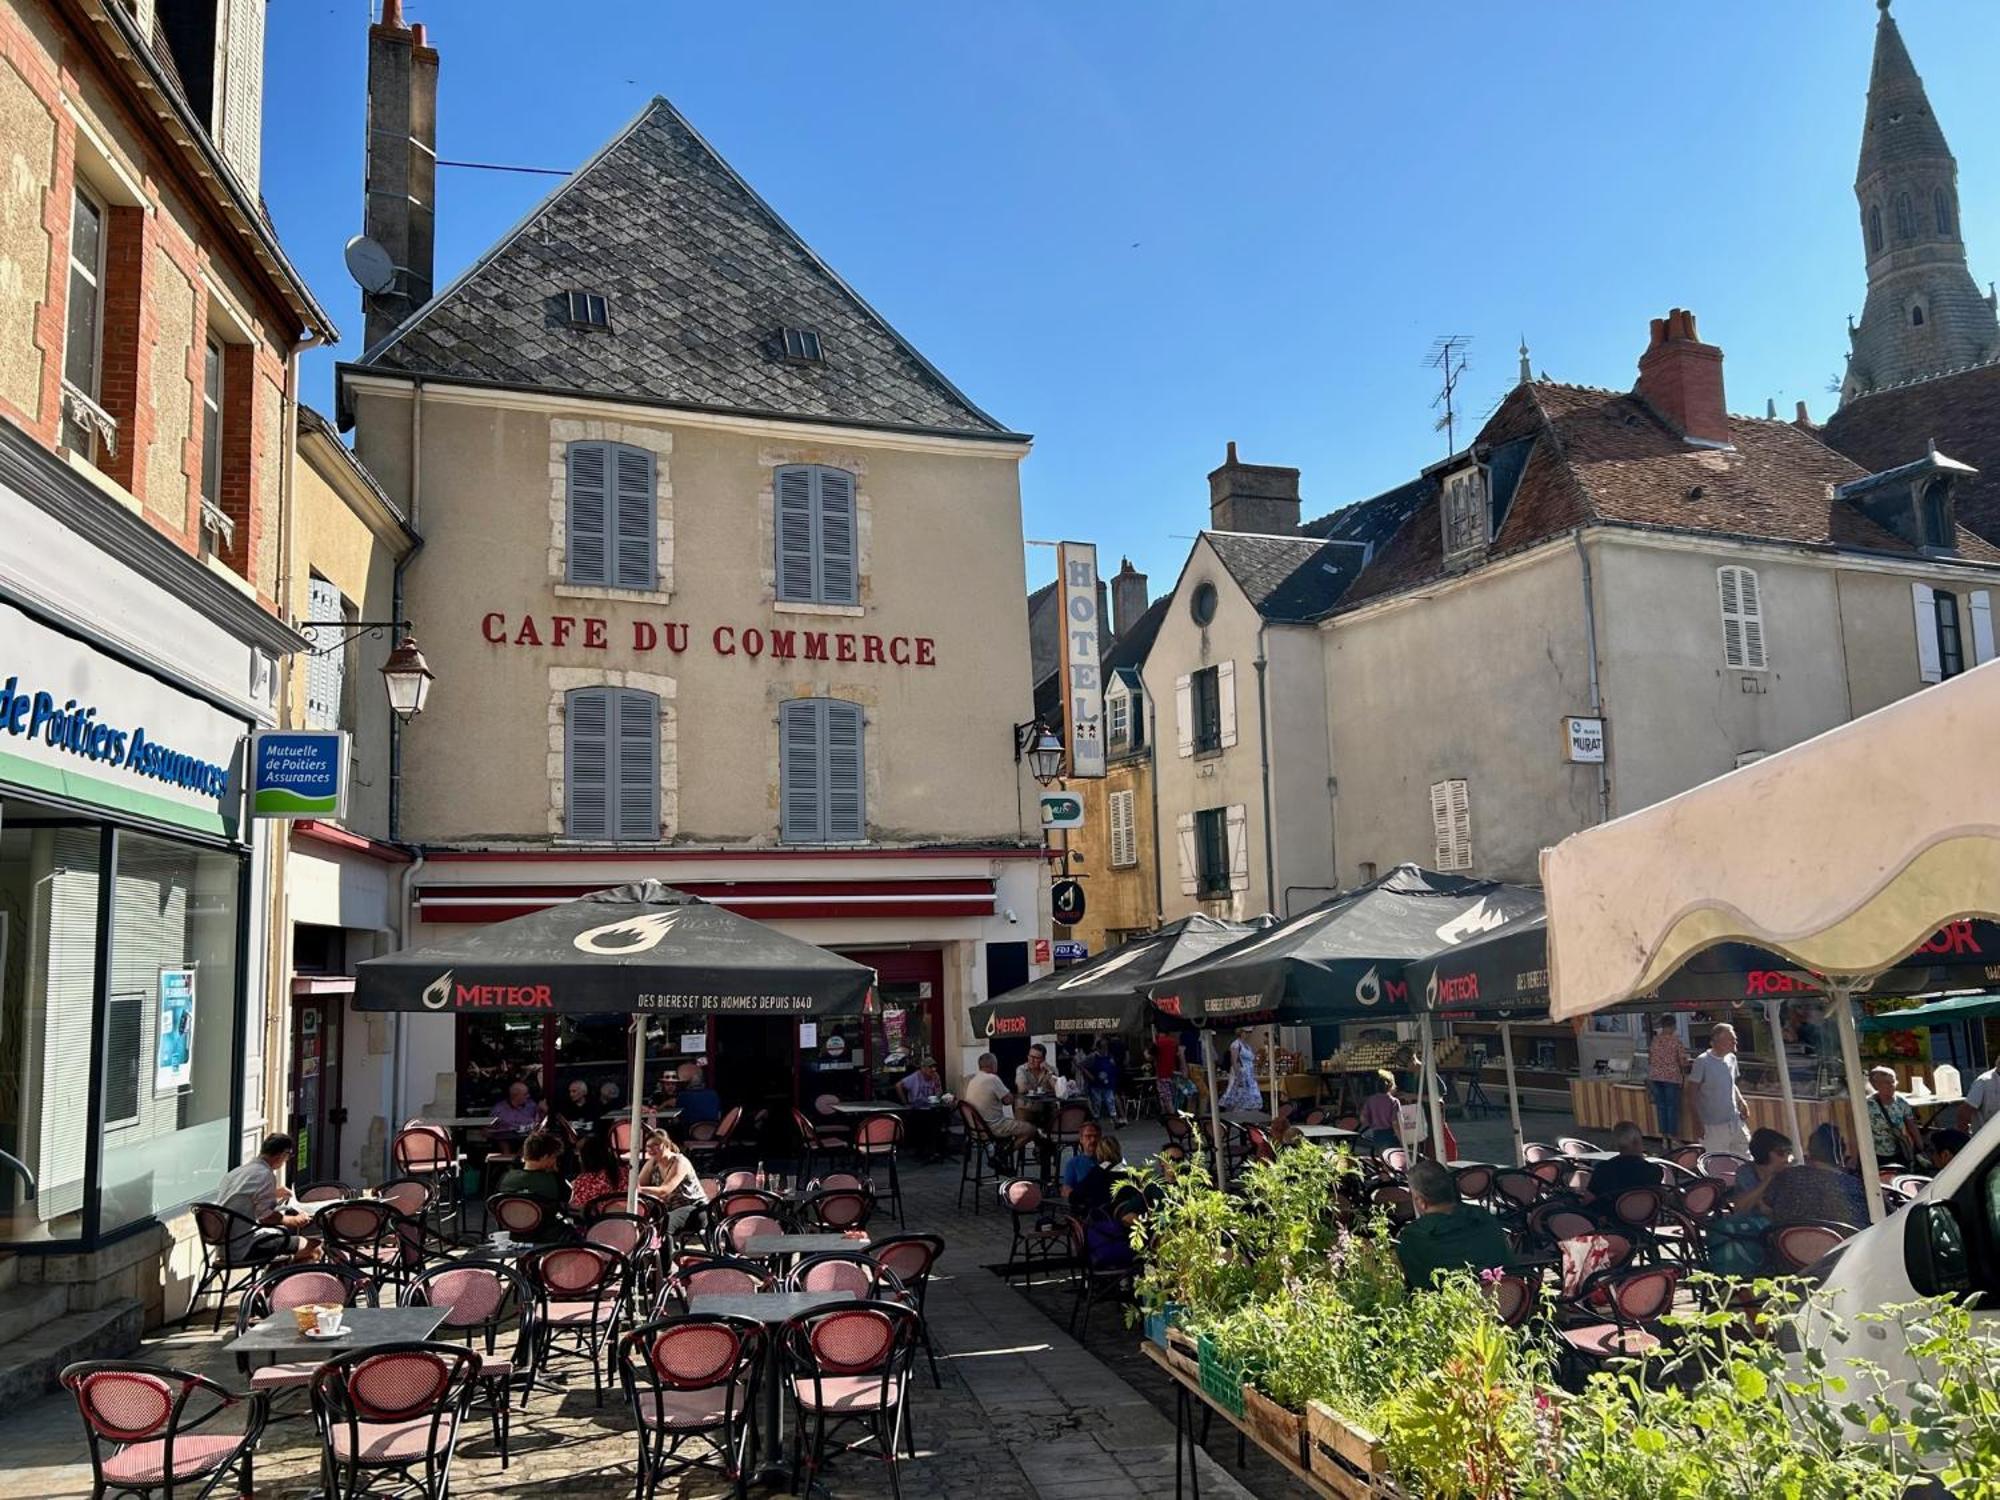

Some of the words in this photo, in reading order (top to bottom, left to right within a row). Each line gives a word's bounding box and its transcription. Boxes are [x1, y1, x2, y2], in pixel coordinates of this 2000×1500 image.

[481, 612, 609, 650] CAFE
[632, 620, 689, 653] DU
[712, 625, 937, 666] COMMERCE
[1068, 560, 1099, 723] HOTEL
[27, 691, 127, 767] Poitiers
[123, 727, 230, 800] Assurances
[266, 744, 318, 757] Mutuelle
[1572, 736, 1601, 752] MURAT
[265, 758, 280, 770] de
[282, 758, 327, 770] Poitiers
[265, 771, 330, 783] Assurances
[455, 983, 554, 1008] METEOR
[1438, 973, 1480, 1003] METEOR
[638, 993, 656, 1008] DES
[657, 994, 688, 1008] BIERES
[688, 995, 699, 1009] ET
[702, 995, 719, 1009] DES
[720, 995, 758, 1009] HOMMES
[759, 995, 790, 1009] DEPUIS
[791, 995, 813, 1009] 1640
[995, 1015, 1027, 1034] METEOR
